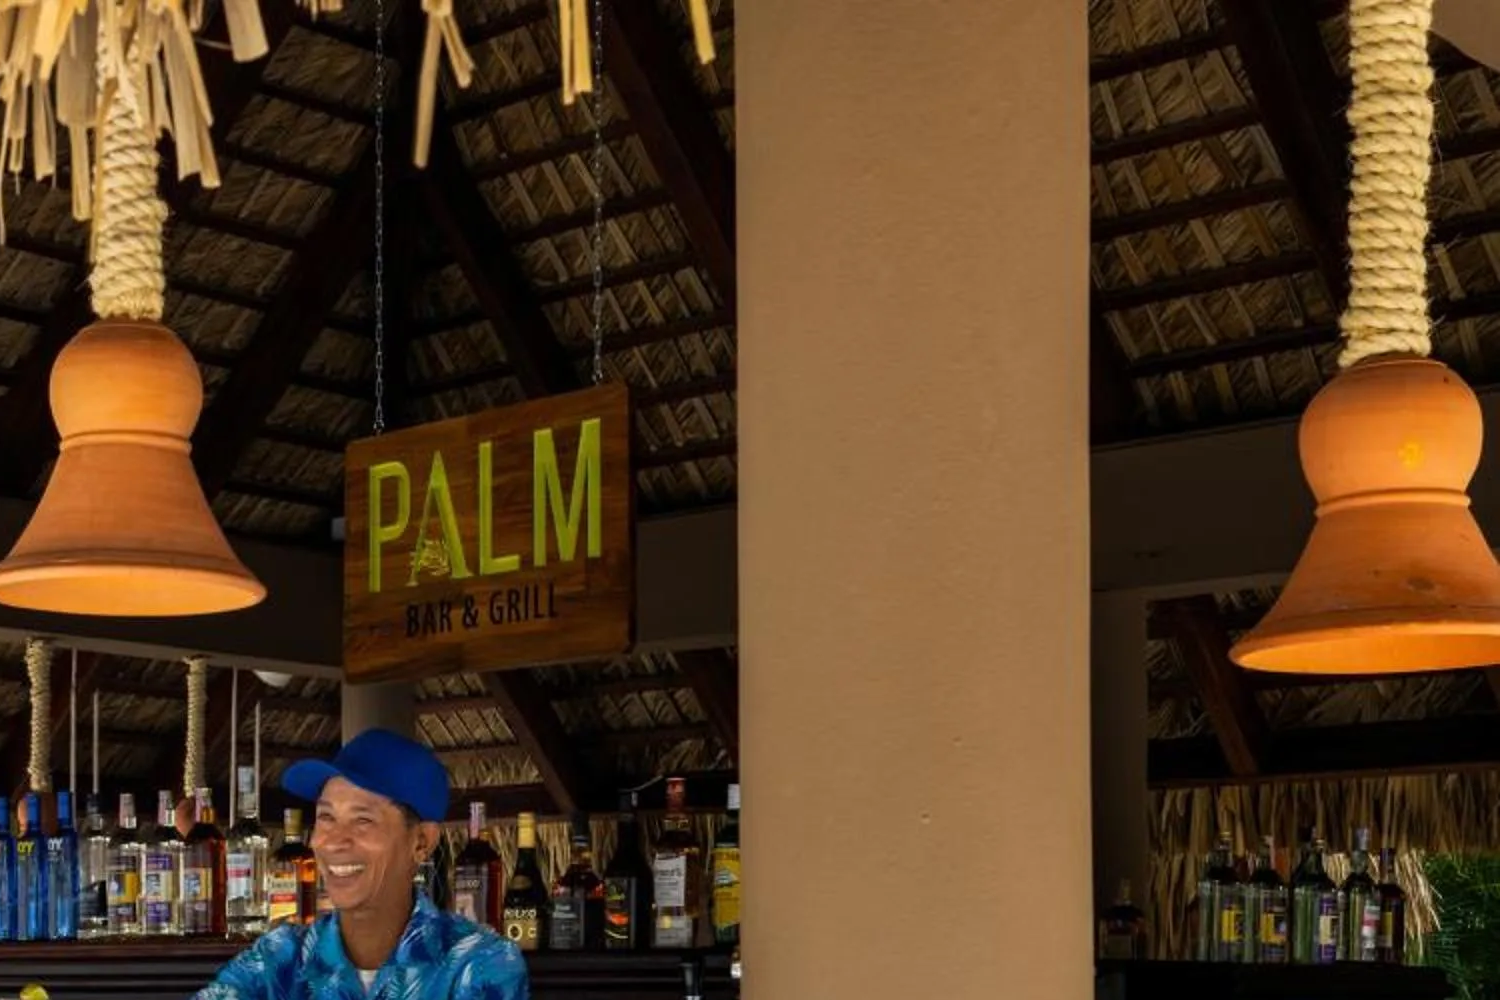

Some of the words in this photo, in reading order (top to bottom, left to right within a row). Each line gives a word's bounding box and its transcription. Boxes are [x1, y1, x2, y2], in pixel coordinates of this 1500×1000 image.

[368, 417, 601, 593] PALM
[405, 599, 452, 638] BAR
[462, 594, 480, 629] &
[489, 581, 559, 625] GRILL
